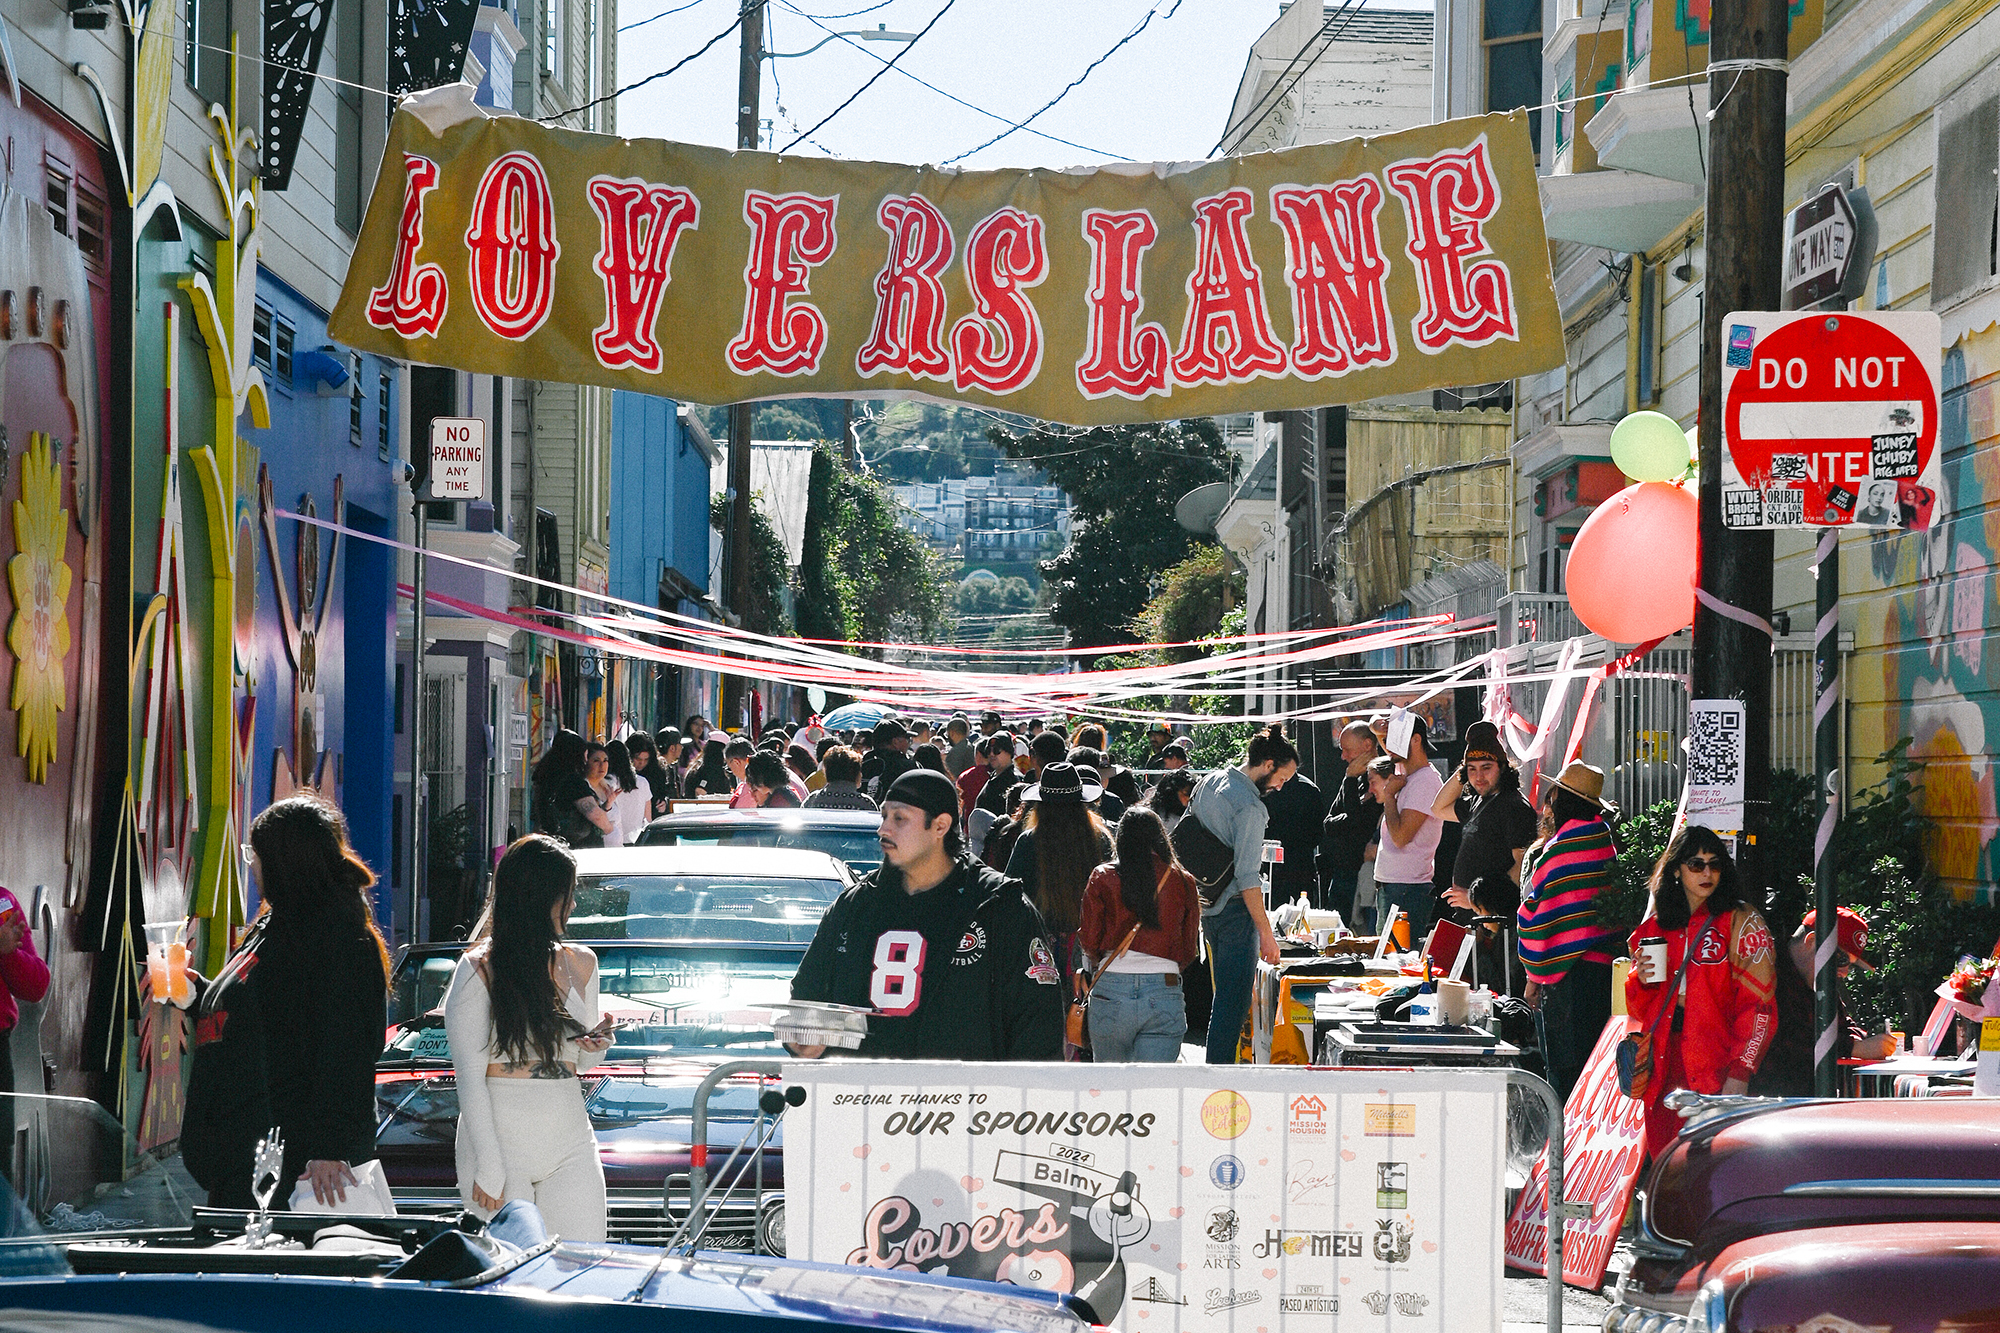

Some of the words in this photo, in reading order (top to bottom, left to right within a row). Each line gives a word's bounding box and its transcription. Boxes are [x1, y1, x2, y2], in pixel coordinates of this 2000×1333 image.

[1788, 238, 1806, 282] ONE
[1810, 224, 1832, 271] WAY
[366, 151, 1049, 394] LOVERS
[1076, 132, 1519, 400] LANE
[1759, 357, 1808, 389] DO
[1835, 356, 1905, 388] NOT
[446, 426, 470, 442] NO
[1873, 434, 1916, 451] JUNEY
[434, 446, 481, 462] PARKING
[1874, 449, 1917, 466] CHUBY
[446, 467, 469, 476] ANY
[445, 481, 469, 491] TIME
[1727, 490, 1760, 504] WYDE
[1767, 490, 1803, 504] ORIBLE
[1728, 503, 1760, 514] BROCK
[1733, 514, 1756, 526] DFM
[1767, 511, 1803, 525] SCAPE
[974, 926, 987, 950] 49ERS
[869, 929, 928, 1017] 8
[418, 1040, 448, 1050] DON'T
[833, 1094, 893, 1106] SPECIAL
[900, 1093, 962, 1105] THANKS
[968, 1093, 988, 1105] TO
[883, 1111, 955, 1136] OUR
[966, 1111, 1156, 1138] SPONSORS
[1056, 1147, 1091, 1163] 2024
[1034, 1162, 1102, 1197] Balmy
[846, 1195, 1069, 1269] Lovers
[1202, 1258, 1241, 1269] ARTS
[1280, 1298, 1301, 1312] PASEO
[1303, 1297, 1339, 1313] ARTÍSTICO
